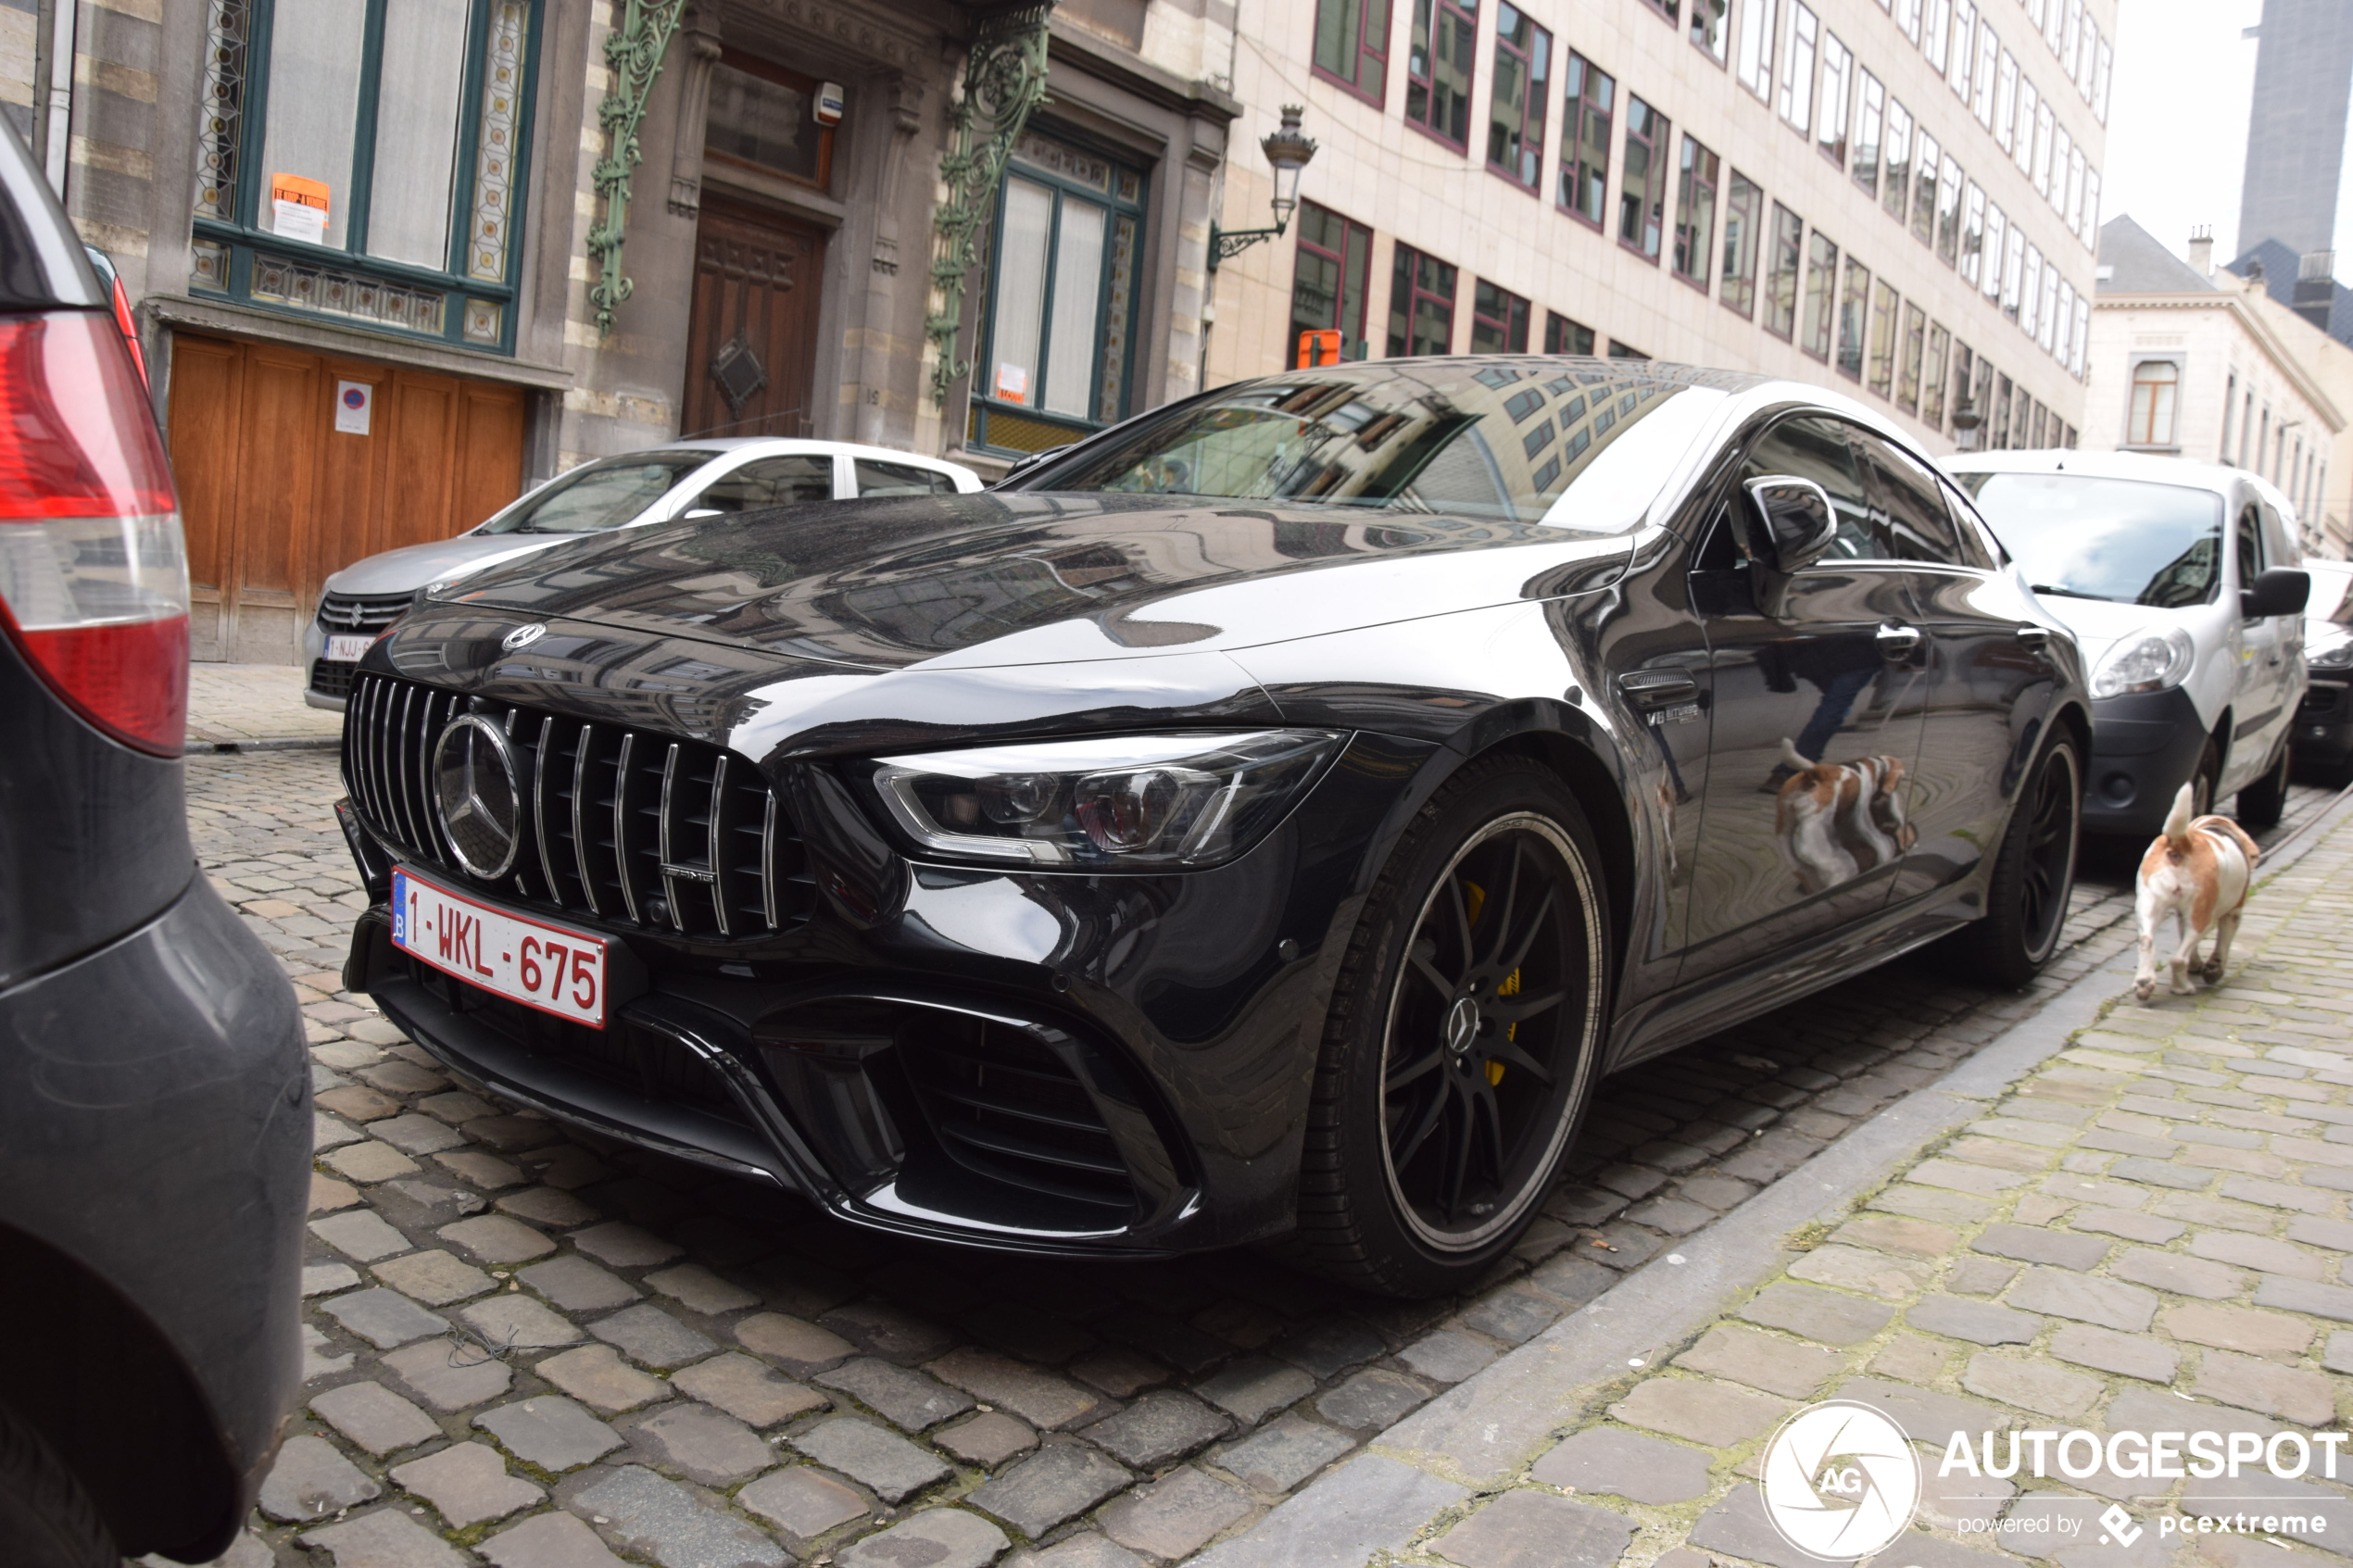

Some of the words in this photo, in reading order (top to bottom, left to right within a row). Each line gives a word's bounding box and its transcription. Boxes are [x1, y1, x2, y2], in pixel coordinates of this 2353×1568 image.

[1646, 710, 1665, 726] V8
[396, 914, 404, 938] B
[410, 891, 596, 1010] 1-WKL-675
